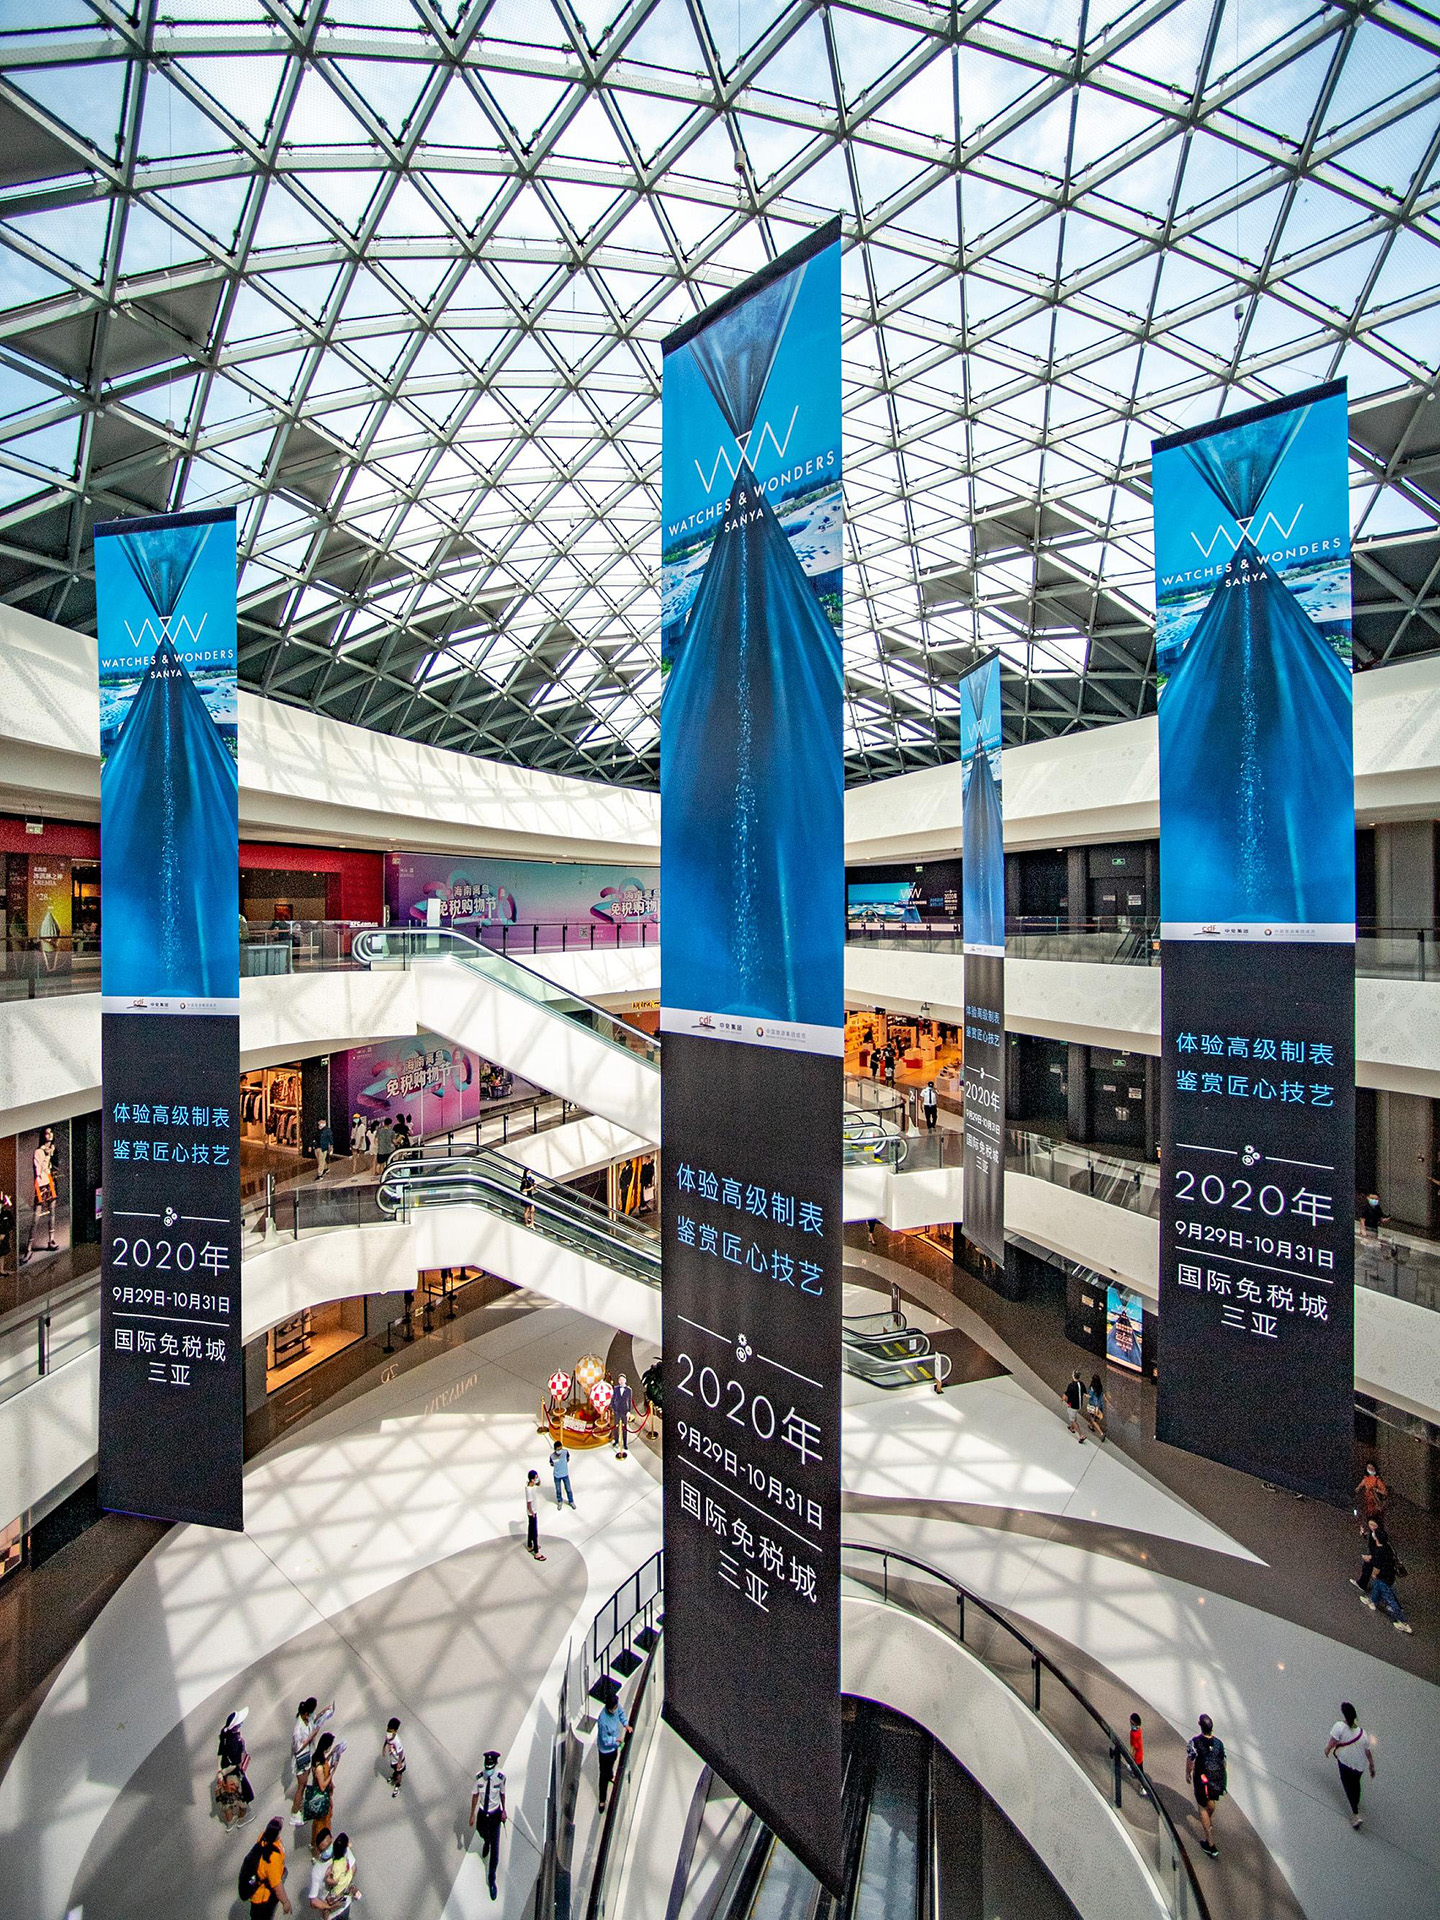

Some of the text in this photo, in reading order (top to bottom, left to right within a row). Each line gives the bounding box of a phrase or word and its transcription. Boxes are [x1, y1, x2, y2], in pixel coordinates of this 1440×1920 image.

[668, 450, 835, 536] WATCHES & WONDERS
[724, 508, 764, 533] SANYA
[1162, 538, 1341, 586] WATCHES & WONDERS
[1225, 572, 1268, 588] SANYA
[102, 649, 234, 668] WATCHES & WONDERS
[150, 669, 183, 679] SANYA
[1176, 1032, 1334, 1066] 体验高级制表
[965, 1081, 1000, 1112] 2020年
[1176, 1070, 1334, 1107] 鉴赏匠心技艺
[113, 1103, 230, 1128] 体验高级制表
[113, 1140, 230, 1165] 鉴赏匠心技艺
[676, 1162, 824, 1237] 体验高级制表
[1175, 1171, 1334, 1227] 2020年
[113, 1237, 230, 1276] 2020年
[677, 1215, 824, 1296] 鉴赏匠心技艺
[1175, 1220, 1333, 1269] 9月29日-10月31日
[113, 1287, 230, 1313] 9月29日-10月31日
[1178, 1263, 1328, 1321] 国际免税城
[1221, 1304, 1278, 1338] 三亚
[115, 1328, 226, 1362] 国际免税城
[148, 1361, 190, 1385] 三亚
[677, 1353, 823, 1465] 2020年
[677, 1421, 823, 1530] 9月29日-10月31日
[681, 1480, 817, 1603] 国际免税城
[718, 1550, 769, 1612] 三亚
